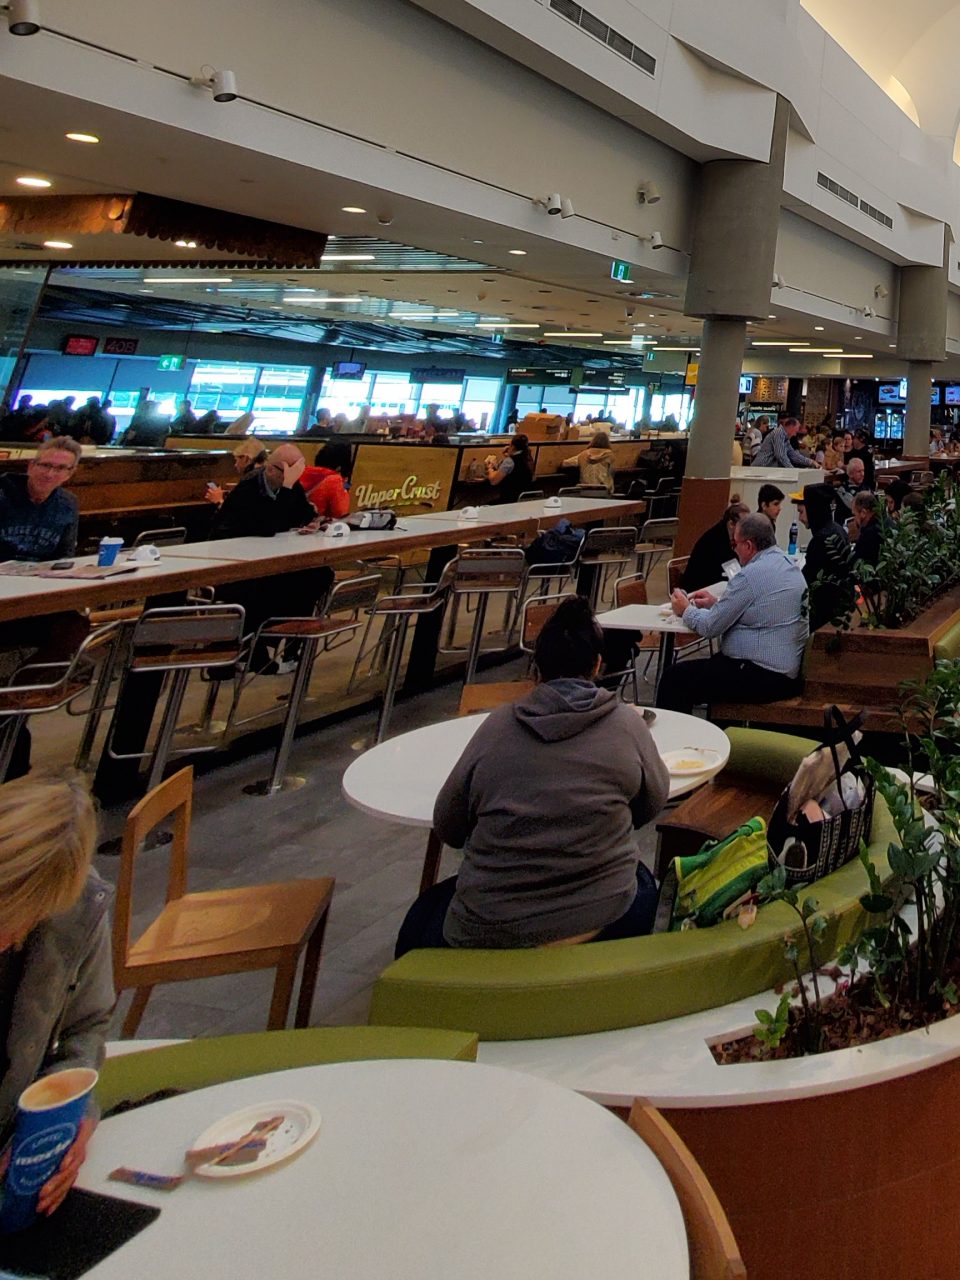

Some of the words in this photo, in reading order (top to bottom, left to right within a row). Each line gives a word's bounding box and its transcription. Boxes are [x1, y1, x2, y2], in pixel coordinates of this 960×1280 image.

[106, 340, 136, 353] 40B
[355, 483, 401, 508] Upper
[401, 475, 441, 500] Crust
